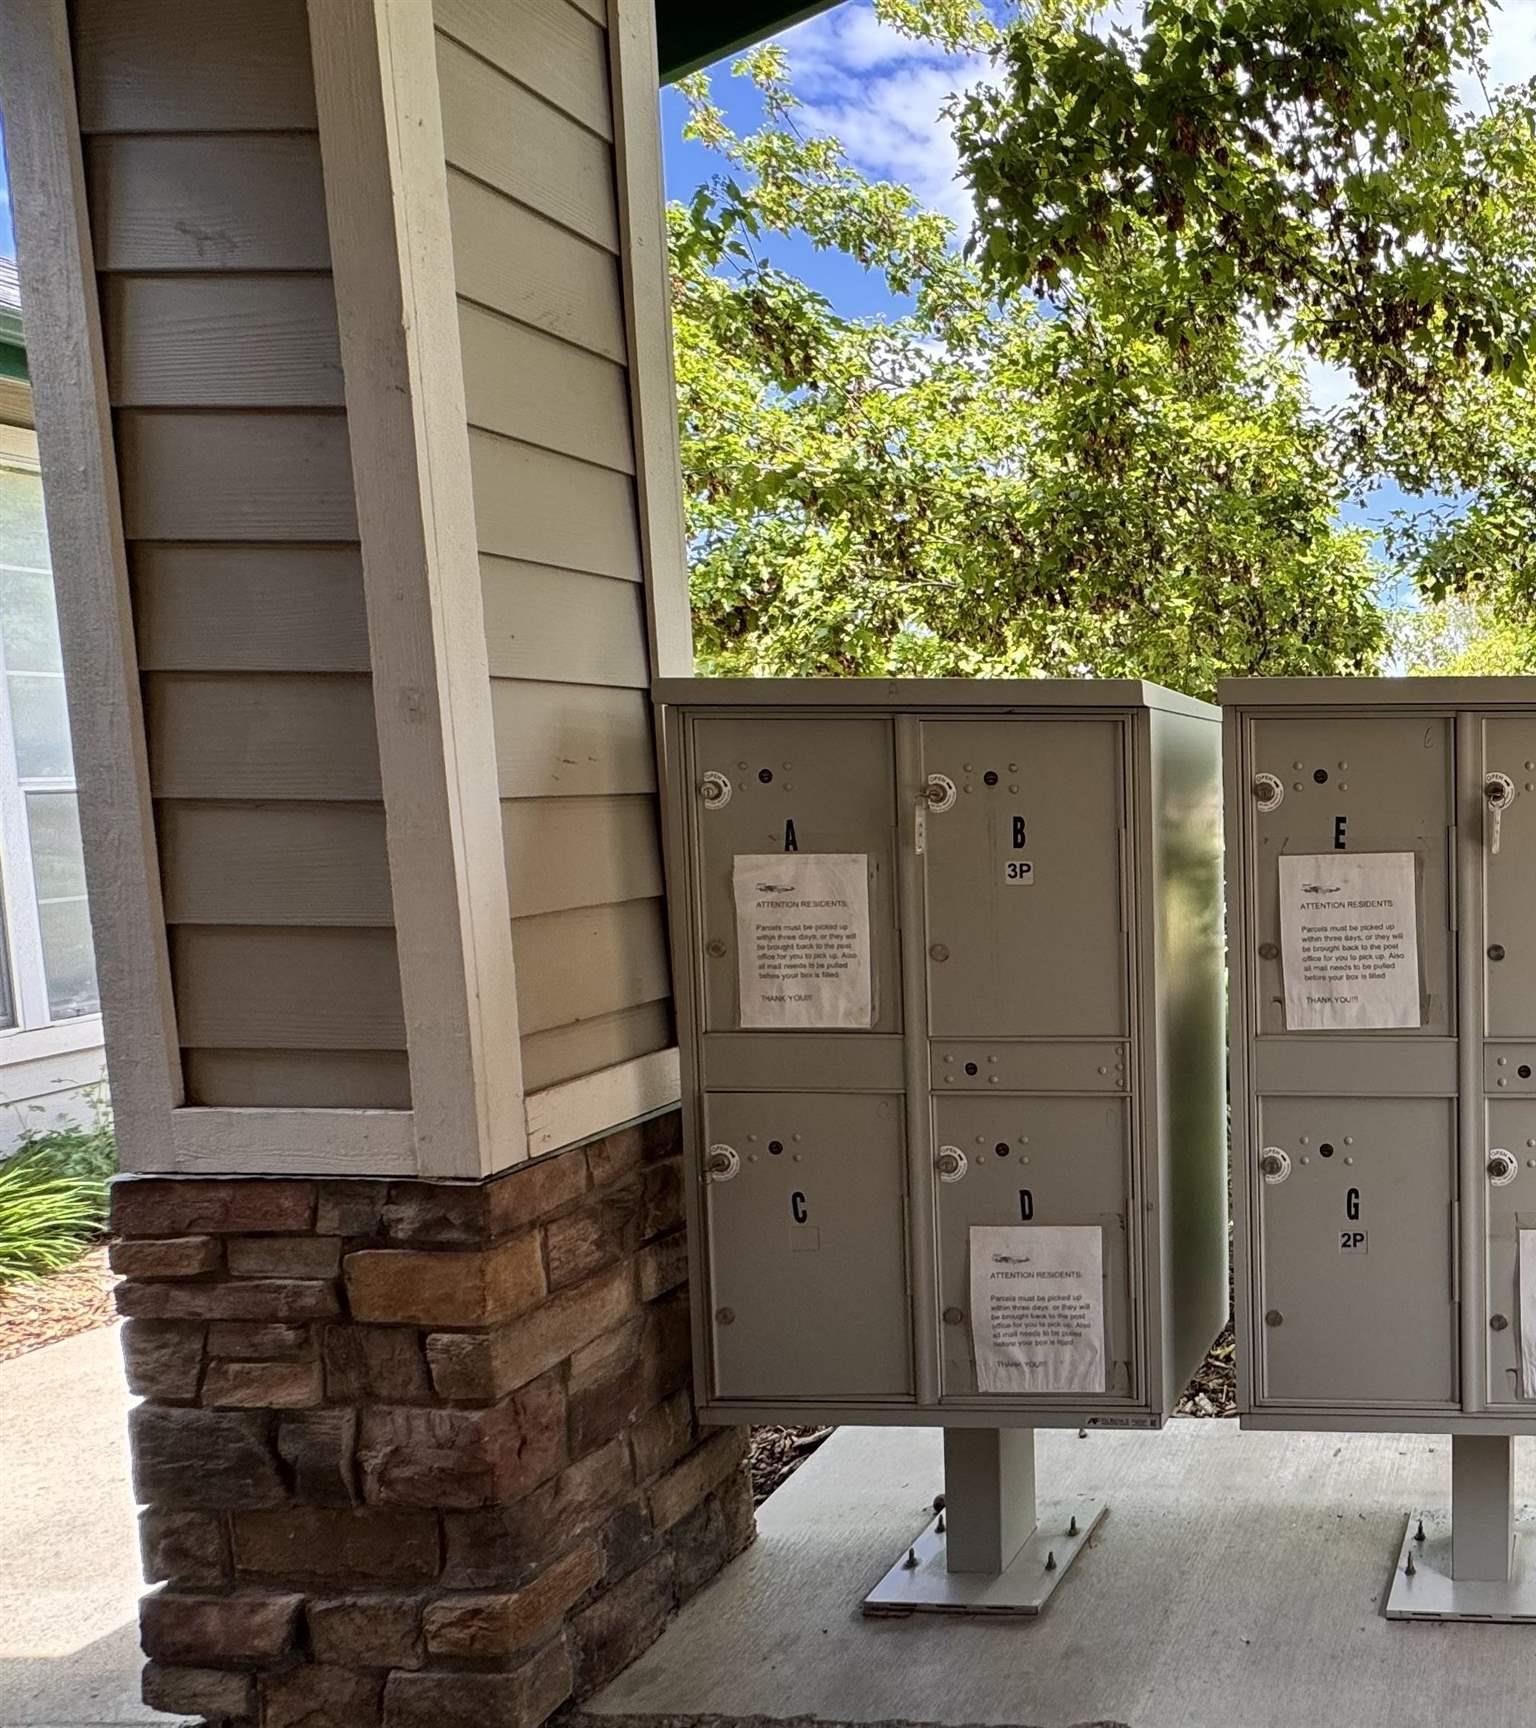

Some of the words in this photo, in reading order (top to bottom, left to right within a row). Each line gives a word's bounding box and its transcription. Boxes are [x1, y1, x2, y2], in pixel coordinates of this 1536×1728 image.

[784, 819, 799, 852] A
[1012, 815, 1026, 849] B
[1334, 816, 1347, 850] E
[1007, 862, 1032, 879] 3P
[791, 1191, 808, 1224] C
[1019, 1189, 1034, 1221] D
[1346, 1187, 1360, 1221] G
[1341, 1232, 1365, 1248] 2P
